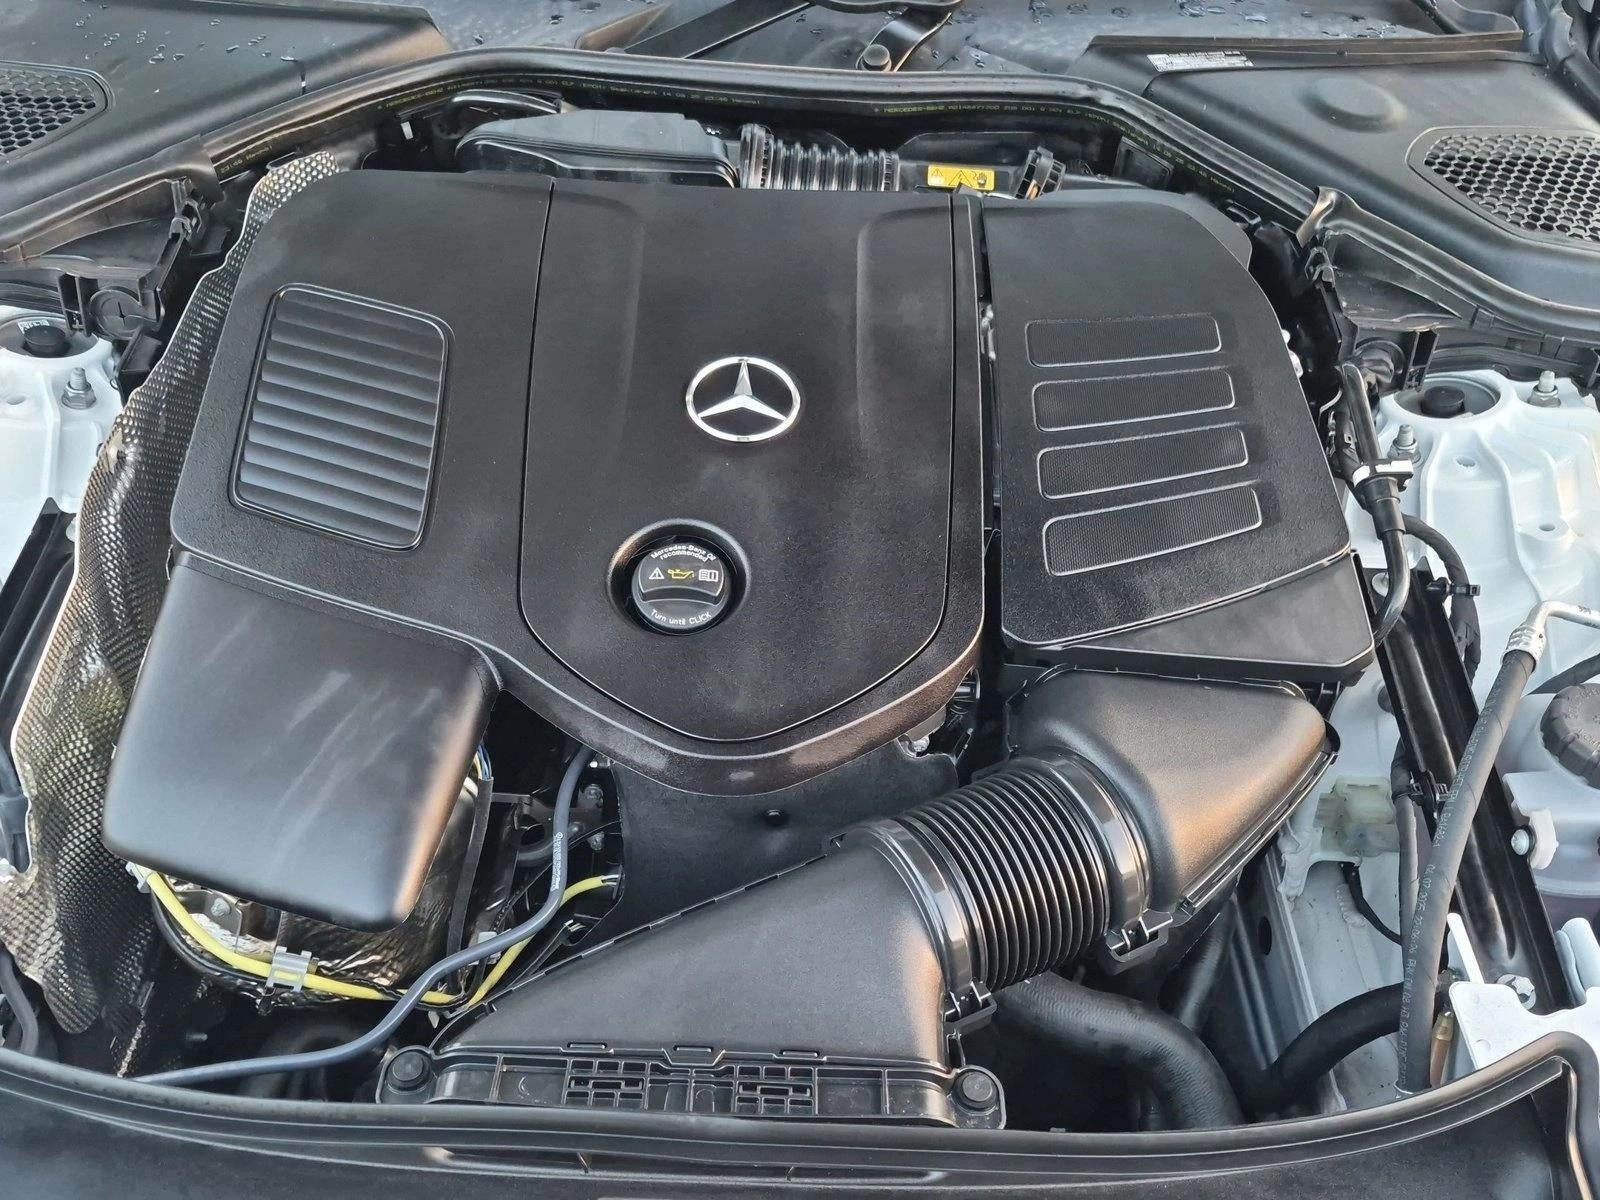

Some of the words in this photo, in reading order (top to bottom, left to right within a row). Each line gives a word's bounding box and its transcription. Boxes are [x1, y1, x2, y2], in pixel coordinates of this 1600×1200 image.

[651, 545, 706, 559] Mercedes-Benz
[660, 550, 709, 562] recommended
[651, 609, 667, 622] Turn
[669, 617, 686, 625] until
[689, 611, 712, 625] CLICK
